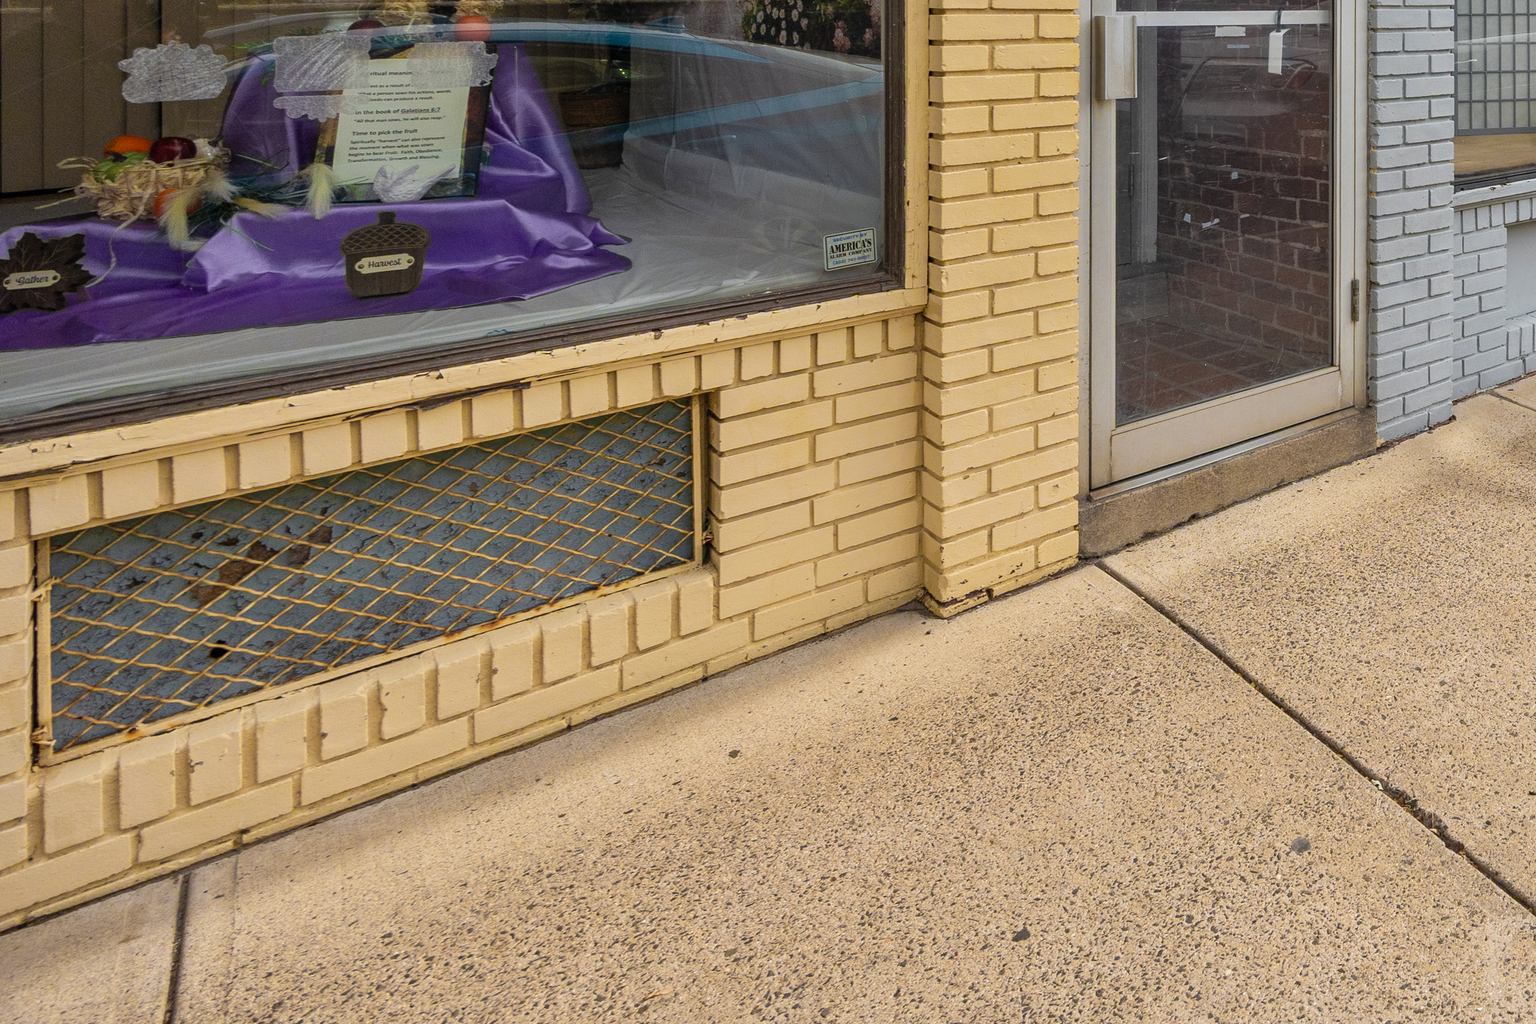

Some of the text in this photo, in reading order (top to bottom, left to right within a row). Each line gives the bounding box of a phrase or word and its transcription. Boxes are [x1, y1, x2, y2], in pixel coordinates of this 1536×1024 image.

[829, 238, 872, 254] AMERICA'S
[368, 258, 402, 268] Harvest
[16, 275, 49, 284] Gather
